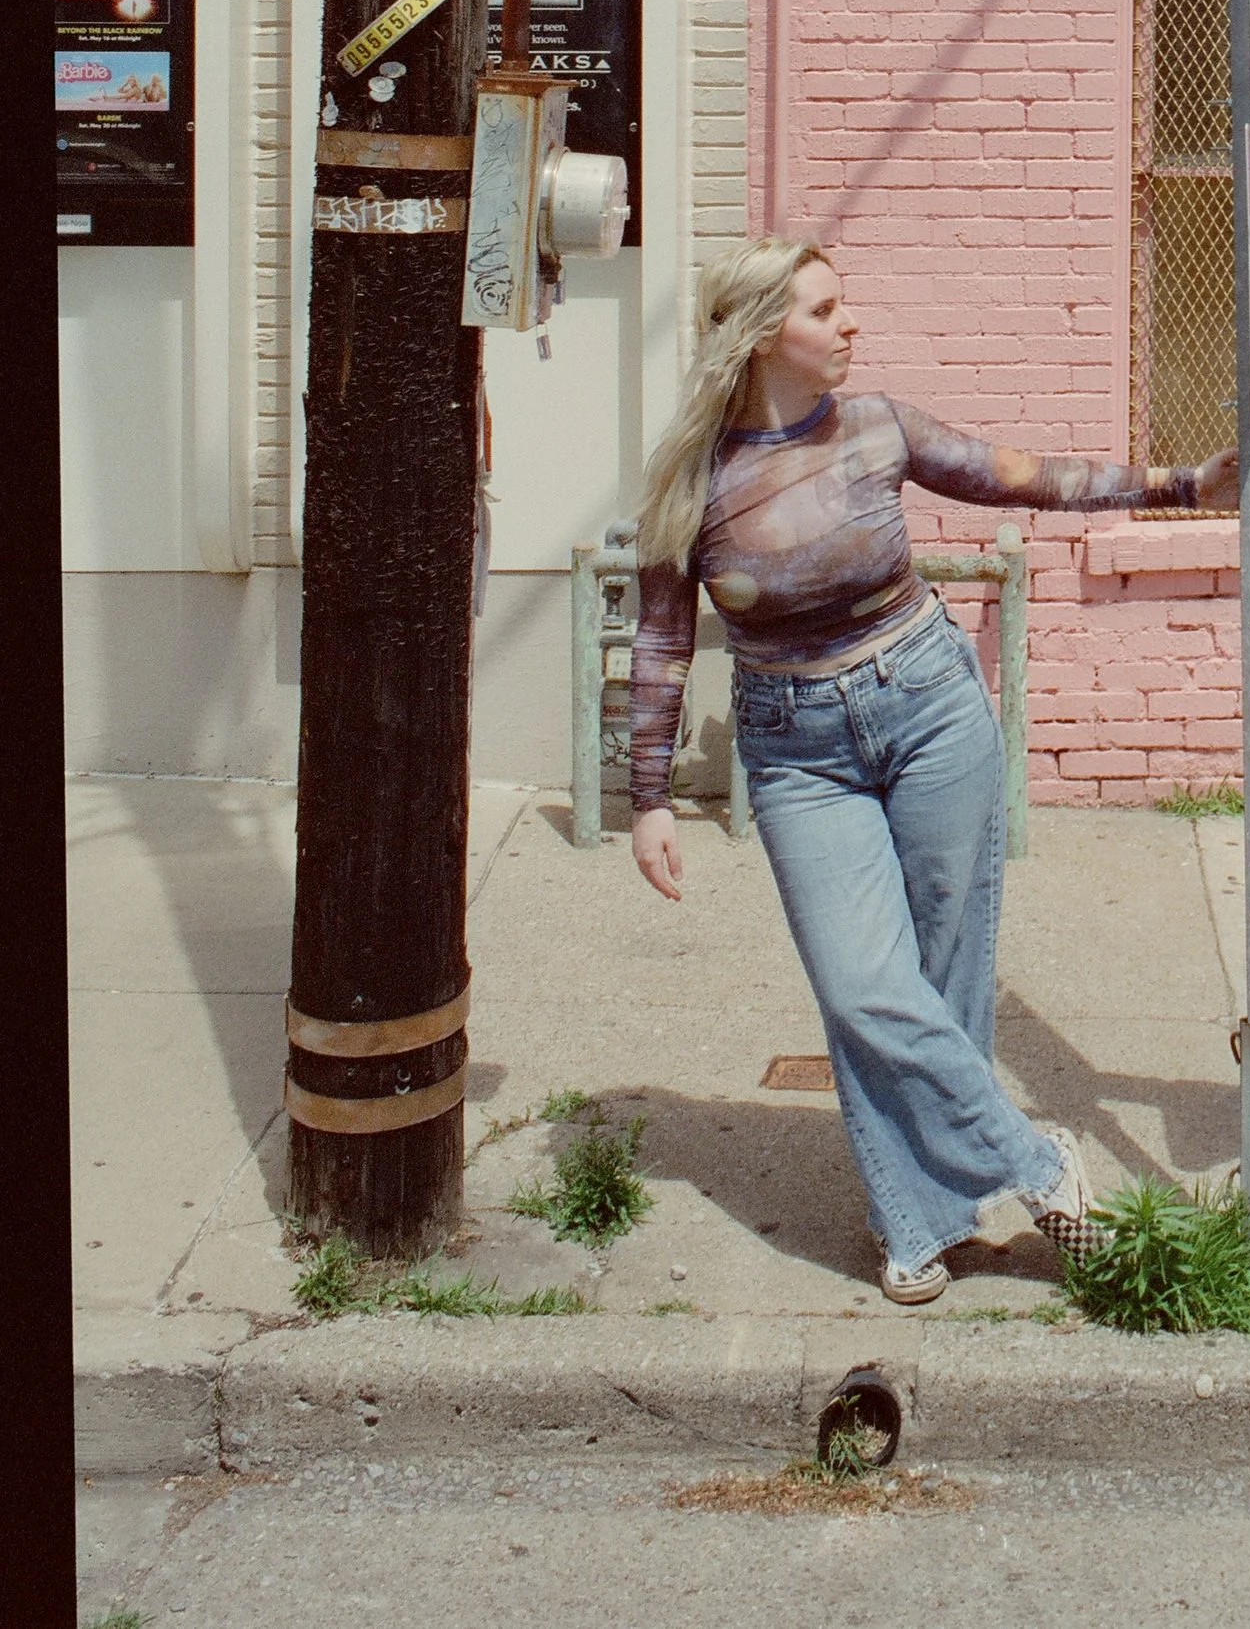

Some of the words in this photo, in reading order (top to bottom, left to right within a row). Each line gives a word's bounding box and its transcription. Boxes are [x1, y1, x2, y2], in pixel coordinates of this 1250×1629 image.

[543, 24, 568, 32] seen.
[532, 34, 567, 44] known.
[488, 55, 591, 69] PAKS
[57, 61, 111, 82] Barbie
